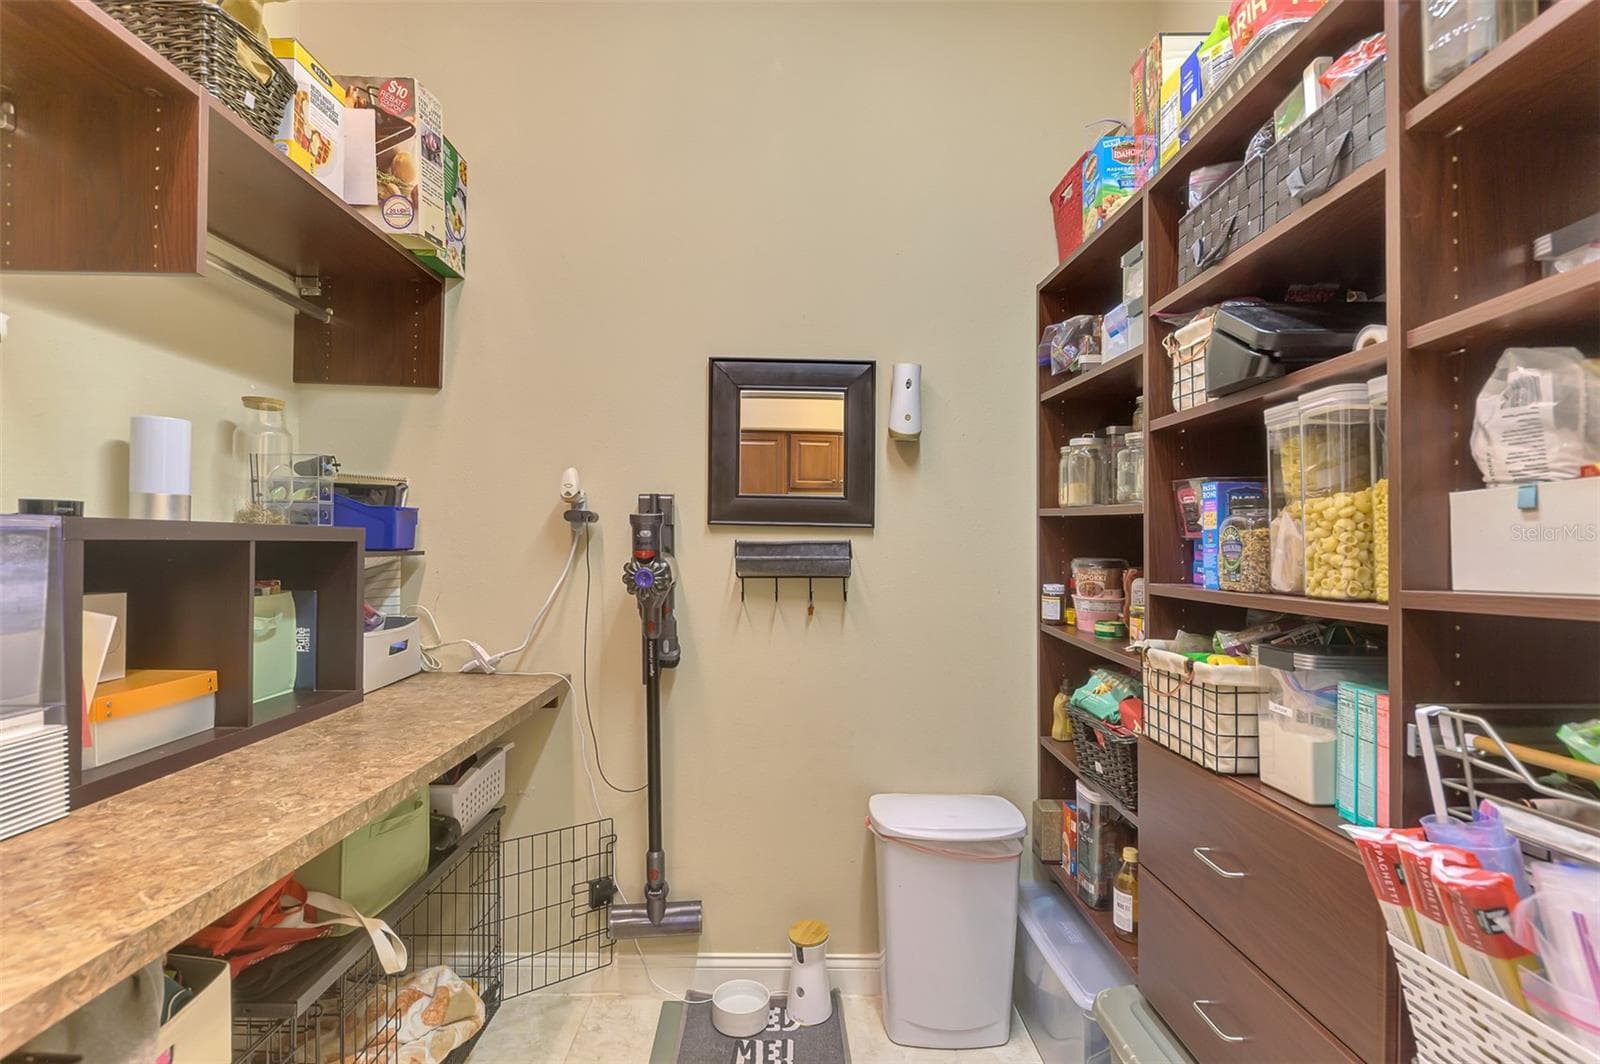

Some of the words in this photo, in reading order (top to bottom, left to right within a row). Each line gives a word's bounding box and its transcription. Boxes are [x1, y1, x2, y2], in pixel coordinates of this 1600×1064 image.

[380, 90, 408, 110] REBATE
[388, 81, 408, 99] $10
[1373, 842, 1400, 904] SPAGHETTI
[1417, 858, 1441, 921] SPAGHETTI
